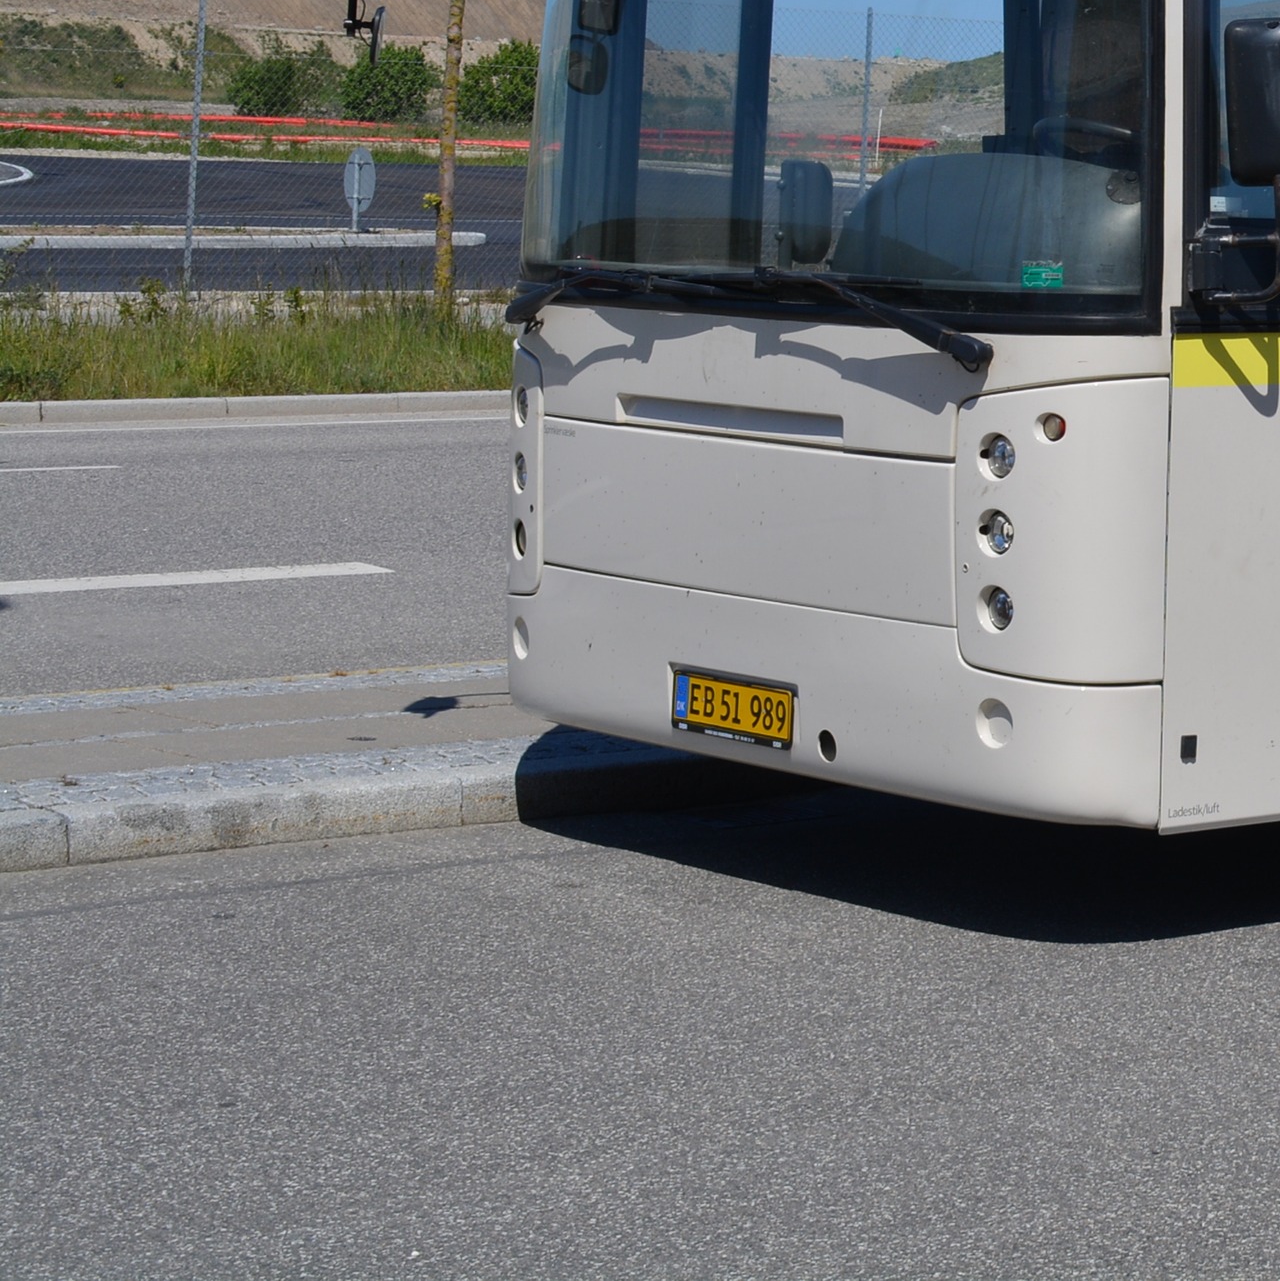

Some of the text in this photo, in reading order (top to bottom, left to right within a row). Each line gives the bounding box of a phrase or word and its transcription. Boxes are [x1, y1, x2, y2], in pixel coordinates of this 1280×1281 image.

[690, 683, 786, 733] EB 51 989
[1168, 802, 1219, 818] Ladestik/luft
